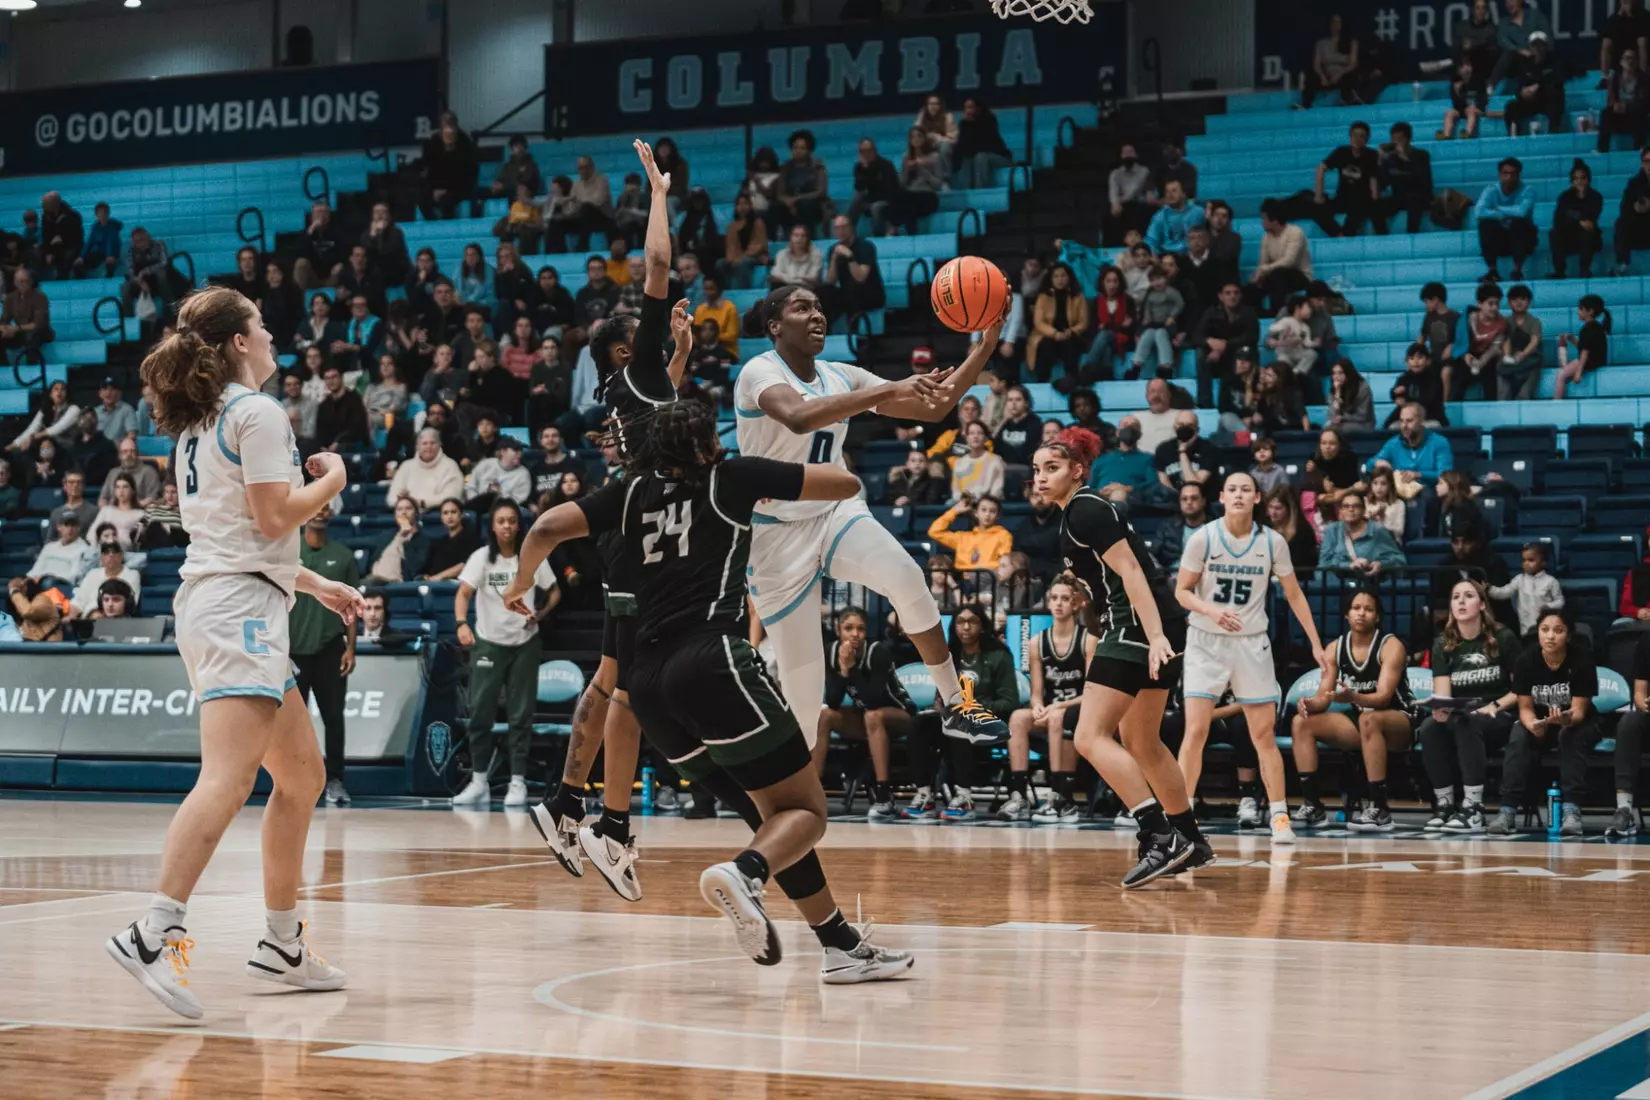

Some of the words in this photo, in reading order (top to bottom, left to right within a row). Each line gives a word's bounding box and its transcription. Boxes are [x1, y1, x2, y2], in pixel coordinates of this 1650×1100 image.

[618, 28, 1043, 113] COLUMBIA
[184, 436, 199, 496] 3
[642, 499, 693, 565] 24
[1213, 576, 1253, 606] 35
[243, 618, 272, 656] C
[1045, 664, 1083, 687] Wagner
[1451, 663, 1501, 682] WAGNER
[61, 688, 197, 716] INTER-CI
